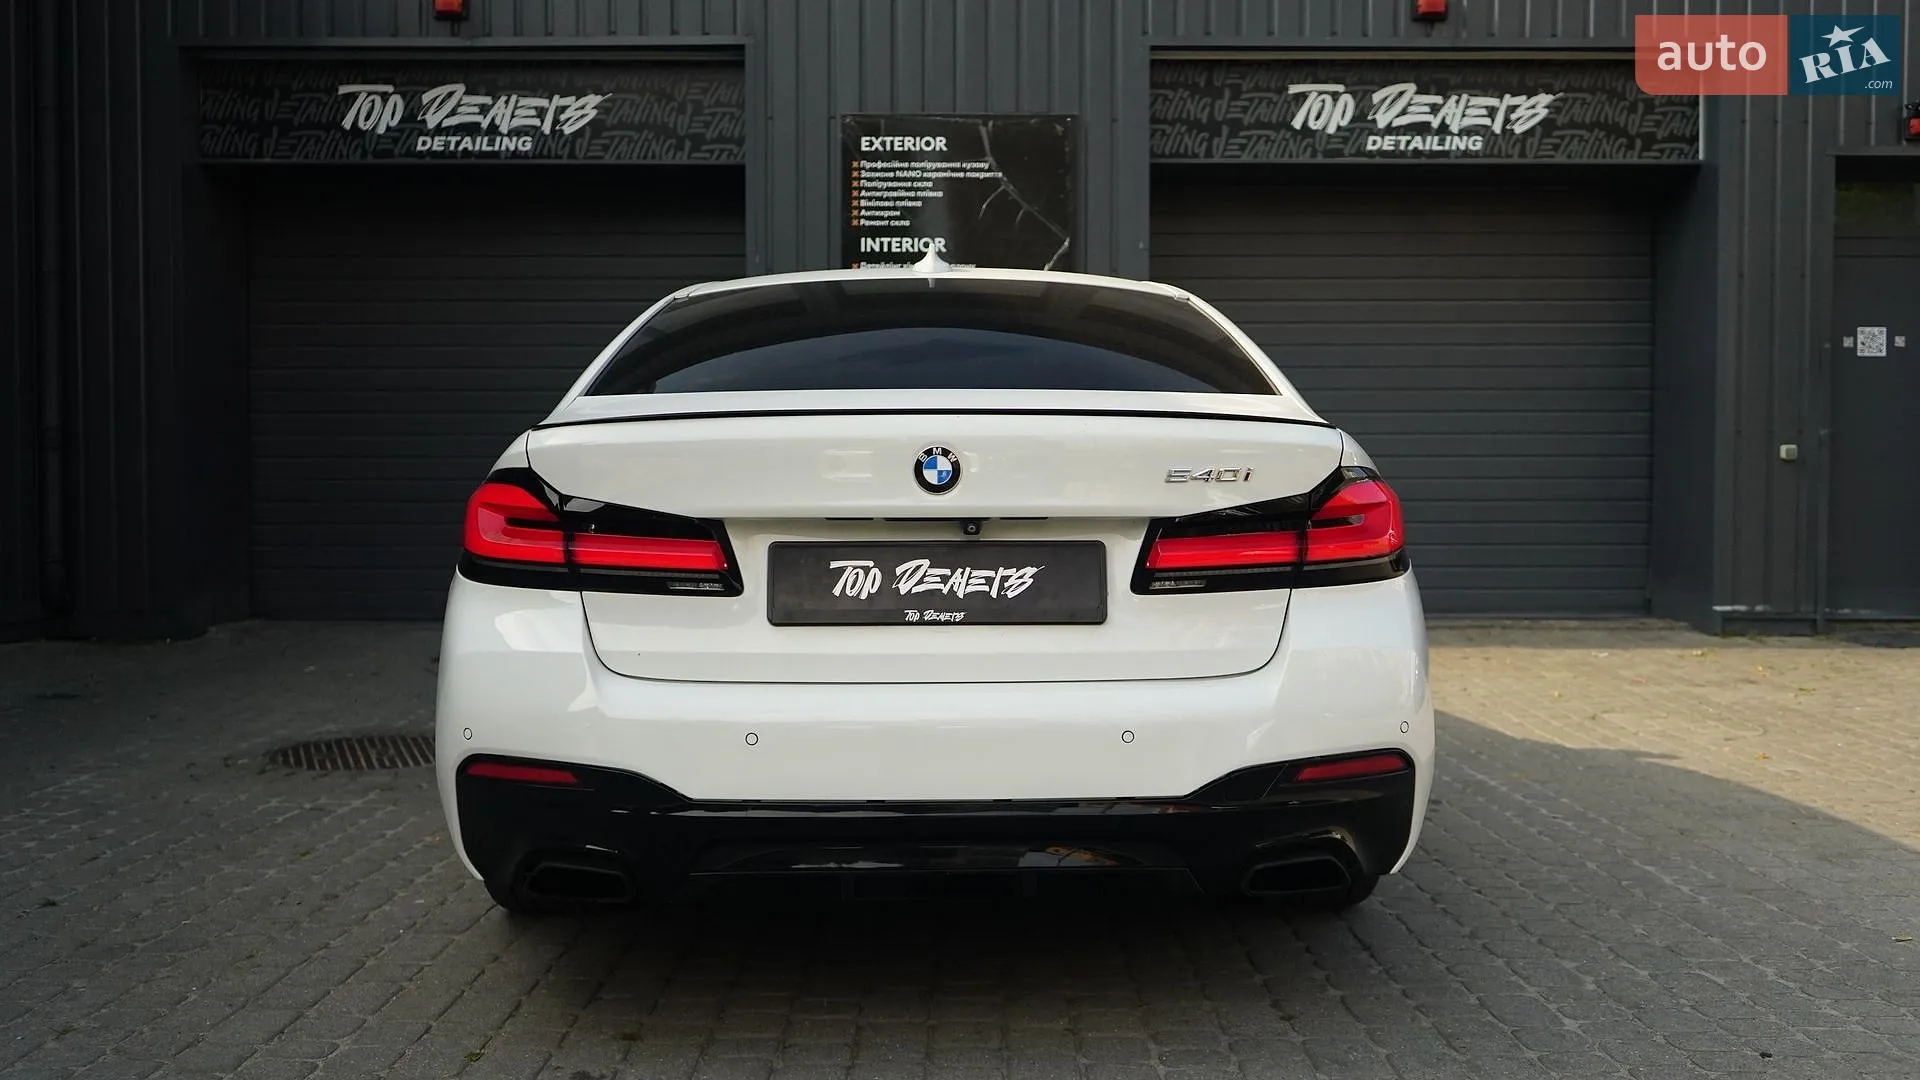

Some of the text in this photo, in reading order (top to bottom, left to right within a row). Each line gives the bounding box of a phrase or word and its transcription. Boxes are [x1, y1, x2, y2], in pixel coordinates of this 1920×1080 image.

[416, 136, 533, 152] DETAILING
[861, 136, 948, 152] EXTERIOR
[1366, 135, 1483, 152] DETAILING
[861, 237, 947, 253] INTERIOR
[919, 447, 957, 463] BMW
[1165, 466, 1254, 483] 540i
